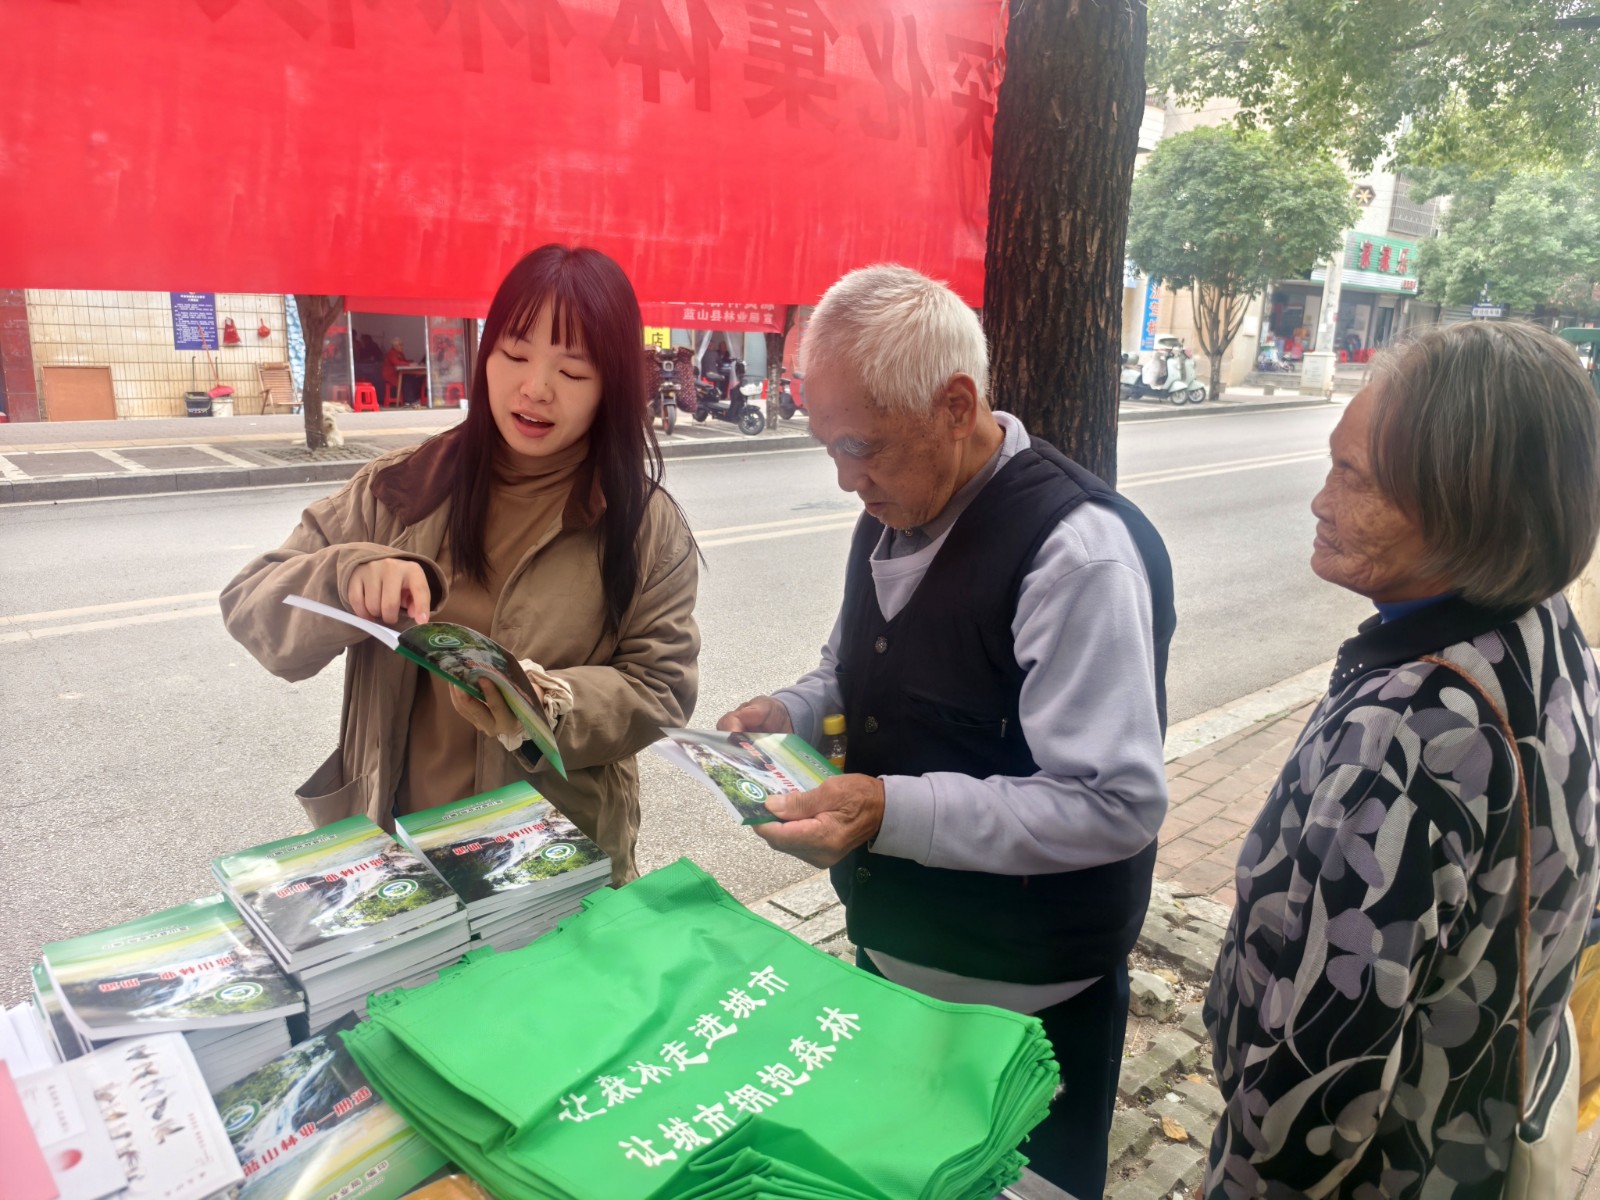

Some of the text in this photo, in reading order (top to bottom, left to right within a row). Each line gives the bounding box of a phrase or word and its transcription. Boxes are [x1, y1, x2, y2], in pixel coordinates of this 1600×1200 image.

[683, 308, 759, 323] 蓝山县林业局
[558, 965, 789, 1123] 让森林走进城市
[618, 1006, 862, 1167] 让城市拥抱森林
